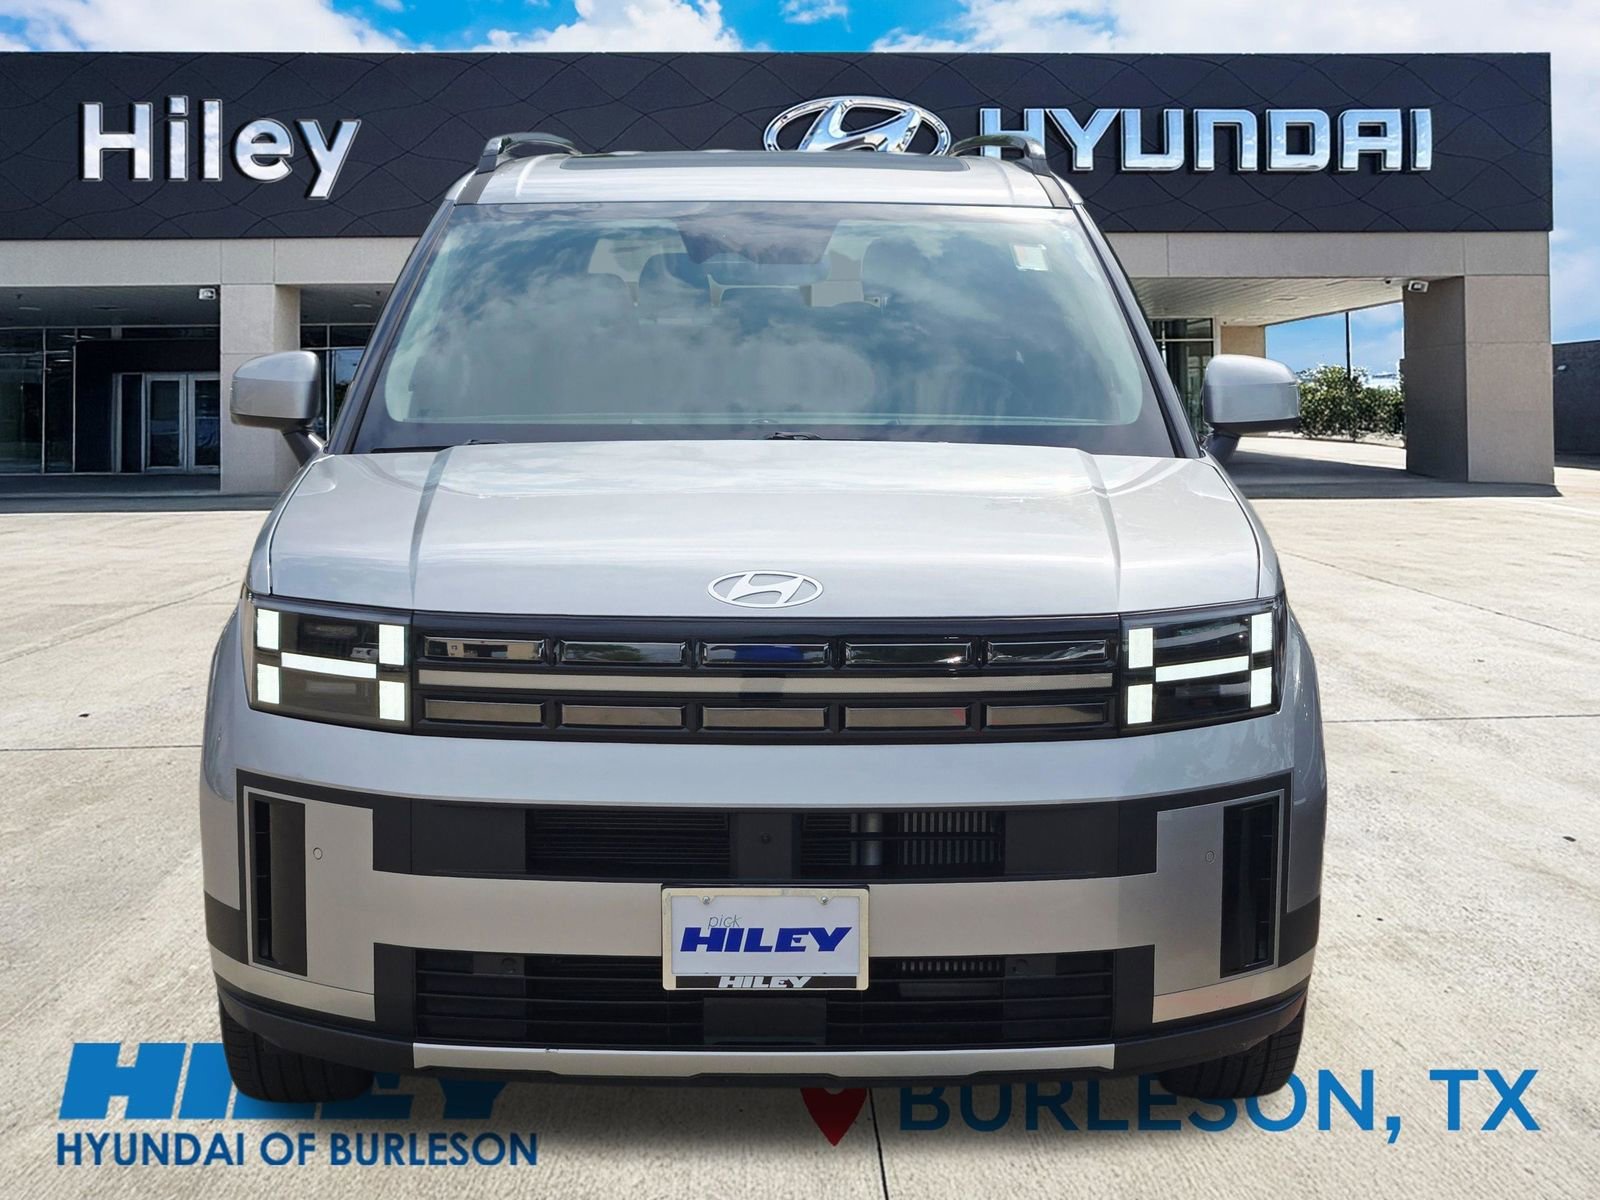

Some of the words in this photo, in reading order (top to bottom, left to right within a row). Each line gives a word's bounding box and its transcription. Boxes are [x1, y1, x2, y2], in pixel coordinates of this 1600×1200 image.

[81, 95, 362, 200] Hiley
[979, 108, 1433, 172] HYUNDAI
[707, 914, 742, 929] pick
[680, 926, 853, 952] HILEY
[718, 976, 812, 988] HILEY
